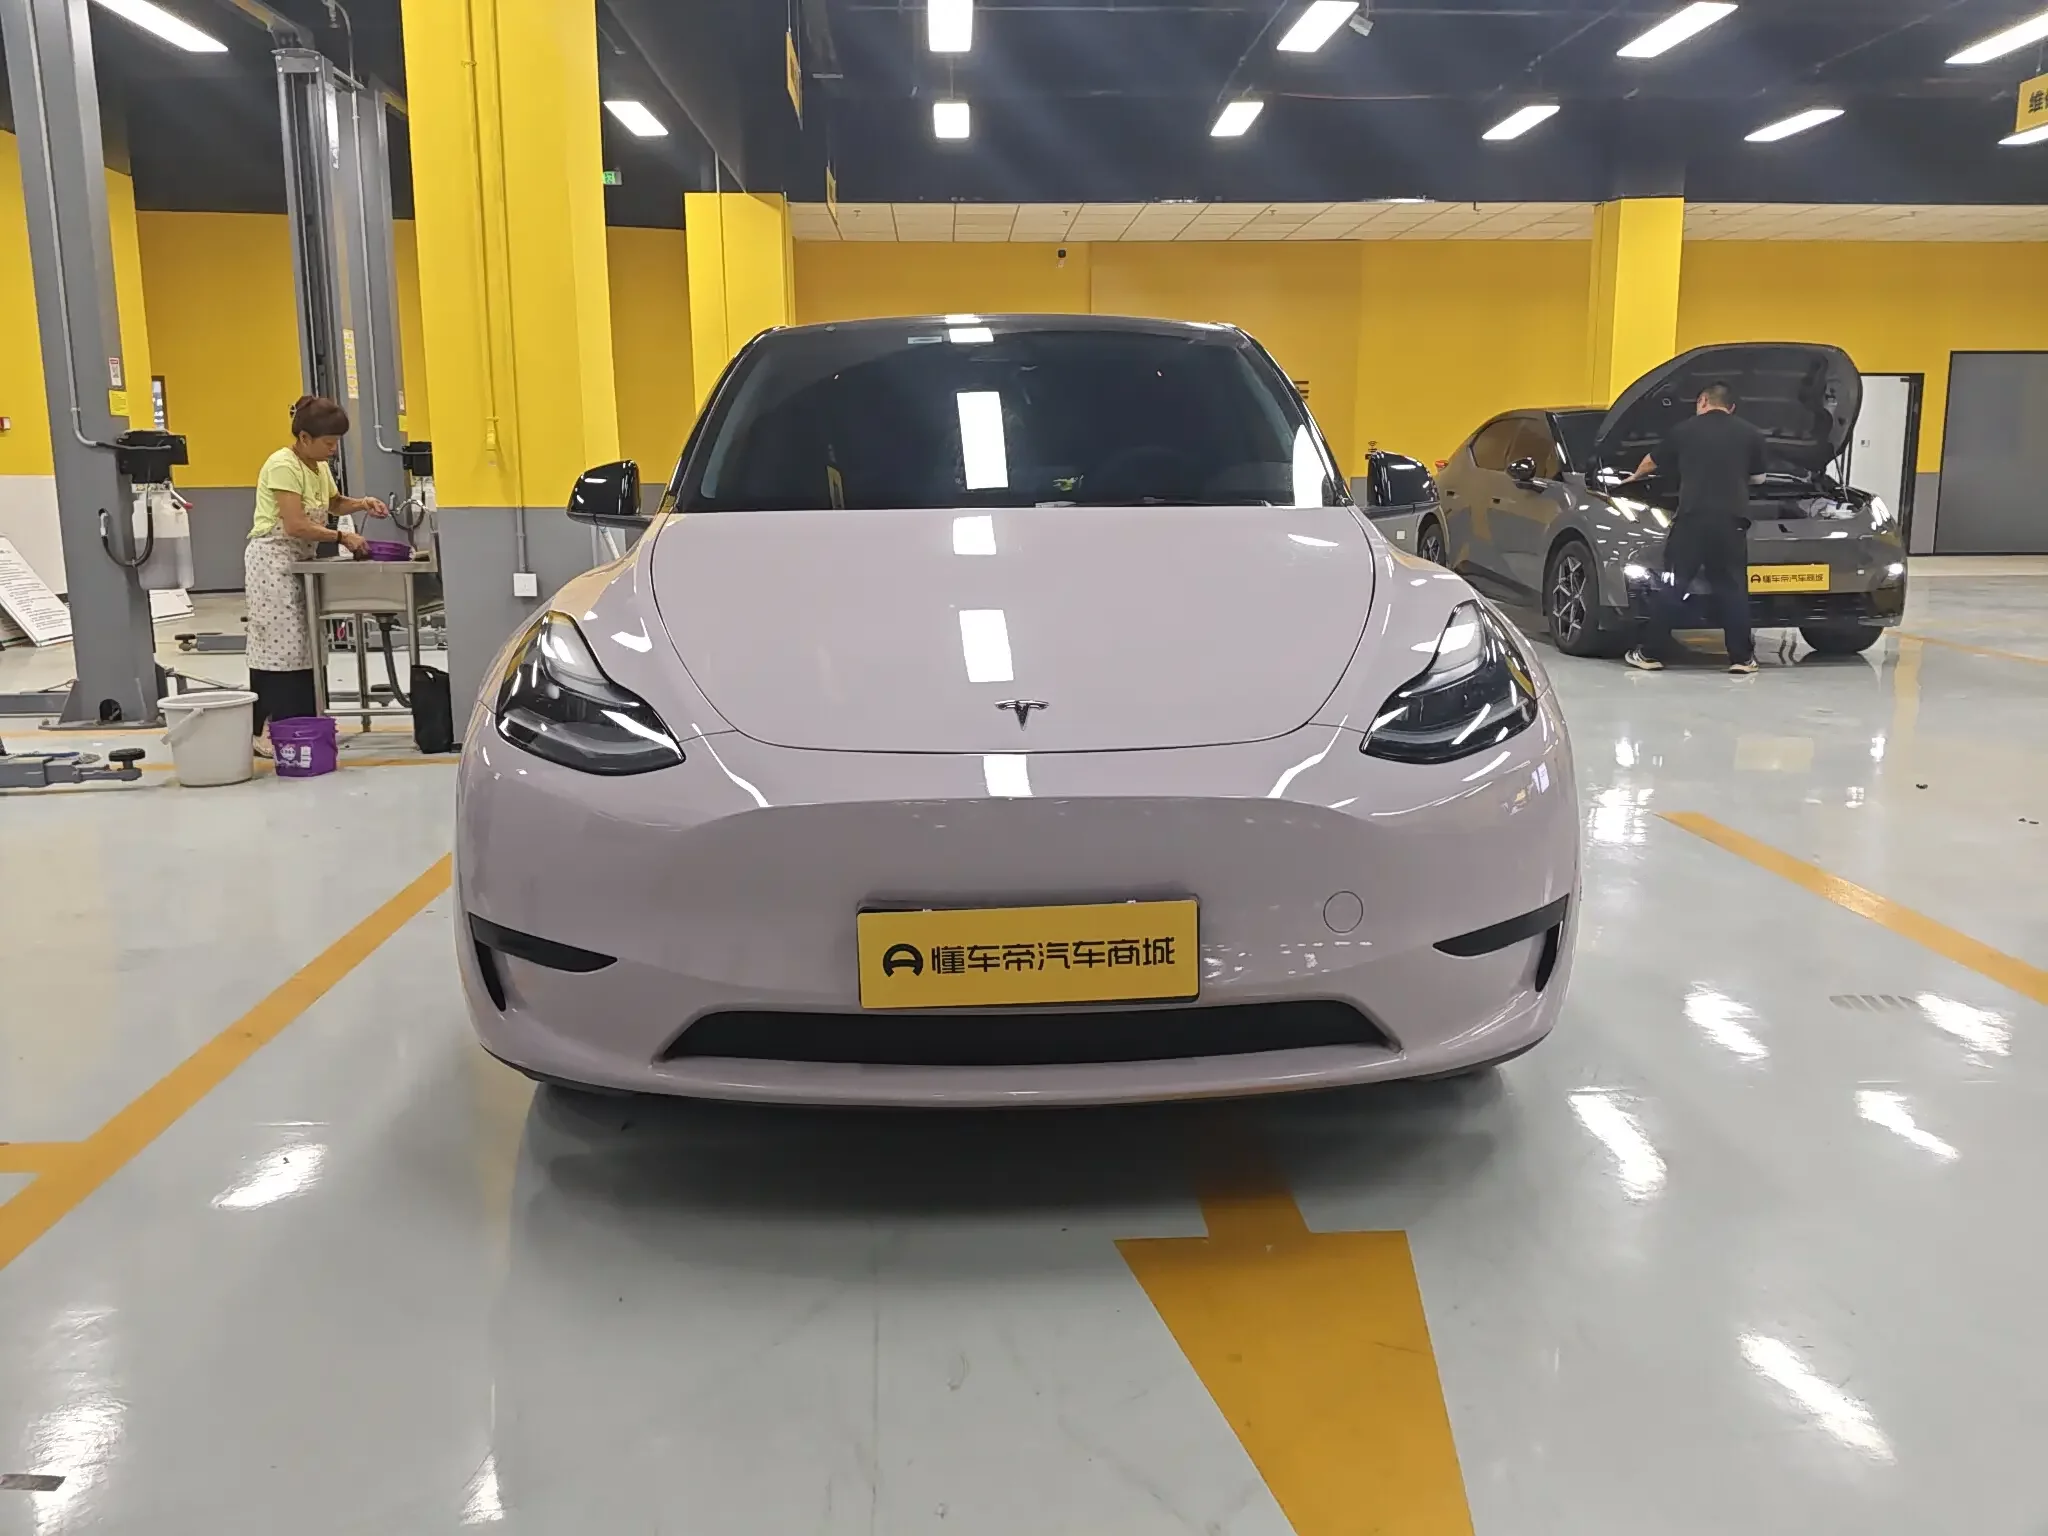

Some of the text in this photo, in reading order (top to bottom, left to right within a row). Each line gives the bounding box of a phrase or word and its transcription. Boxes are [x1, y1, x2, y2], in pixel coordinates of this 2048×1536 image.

[2028, 88, 2048, 114] 维
[931, 936, 1175, 975] 懂车帝汽车商城
